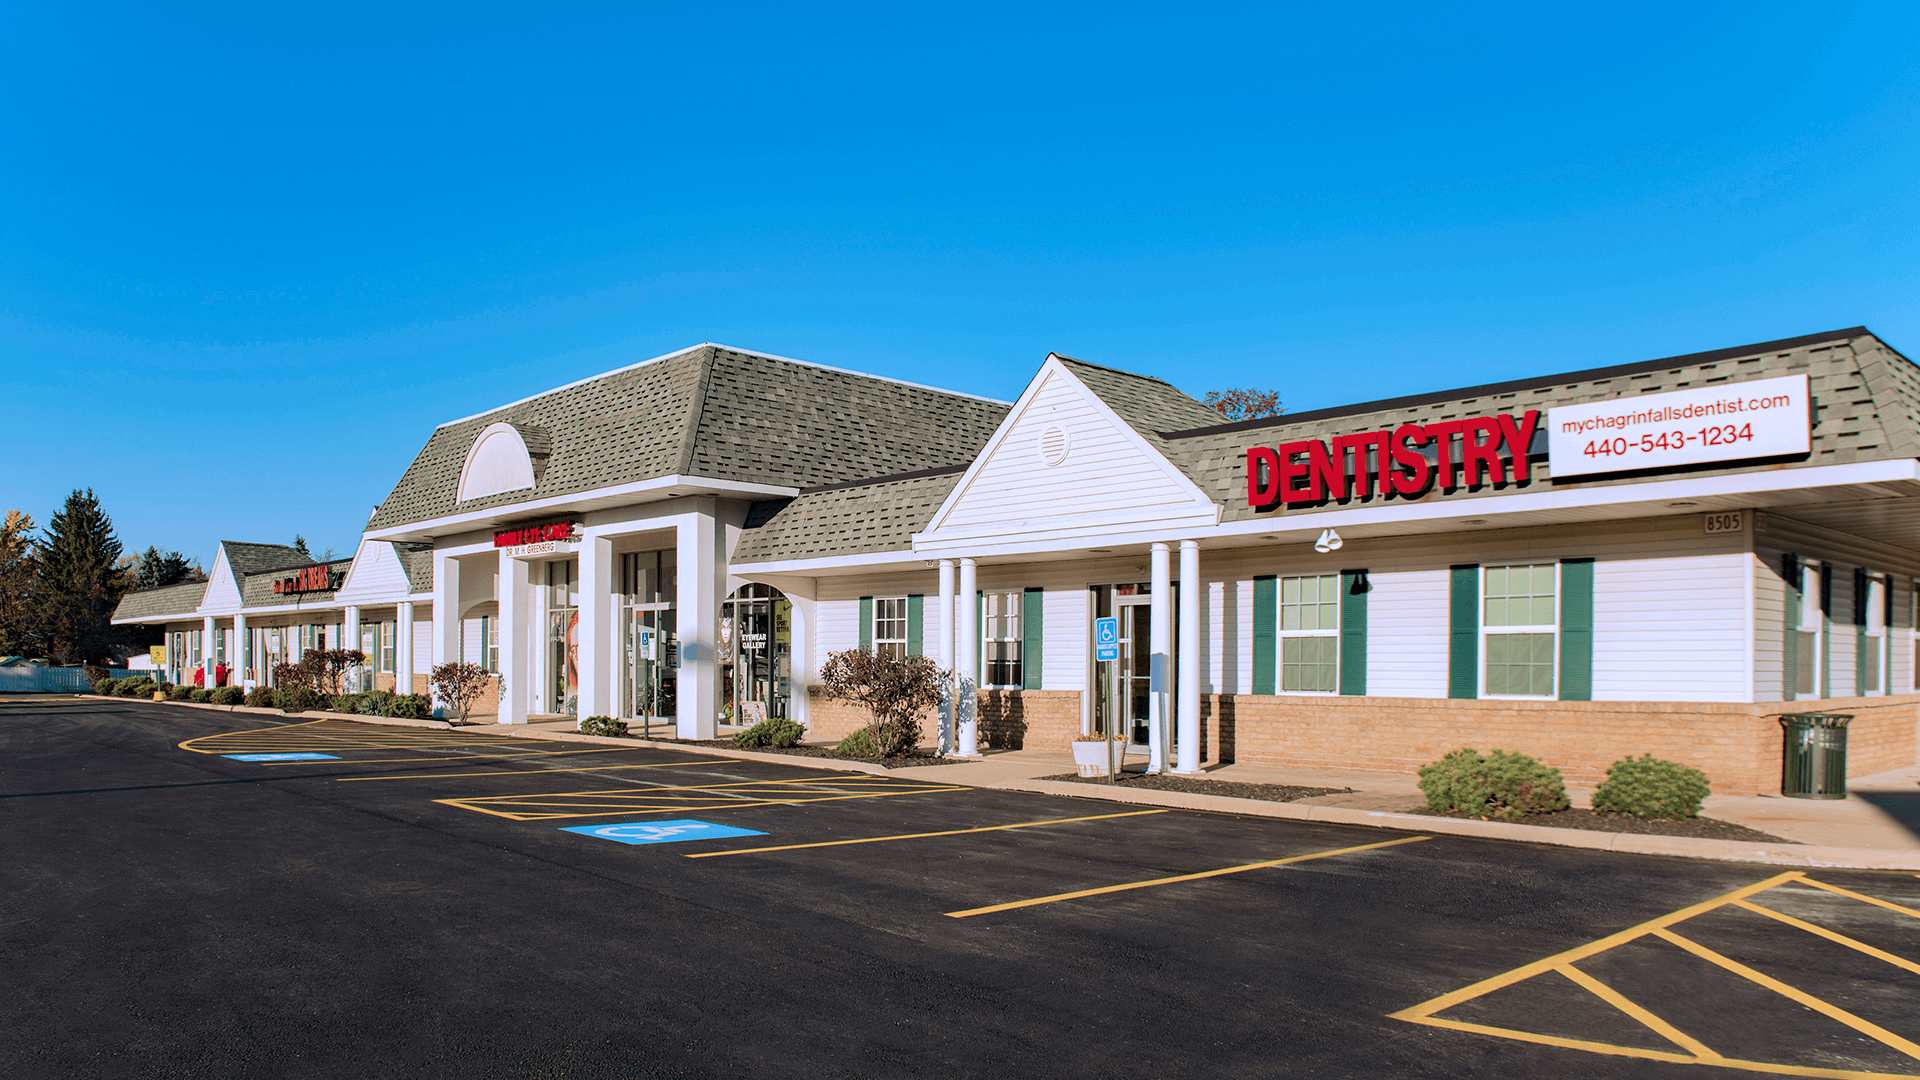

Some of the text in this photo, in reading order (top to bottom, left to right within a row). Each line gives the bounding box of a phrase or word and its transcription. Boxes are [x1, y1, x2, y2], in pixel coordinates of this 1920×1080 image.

[1562, 395, 1790, 434] mychagrinfallsdentist.com
[1583, 423, 1754, 458] 440-543-1234
[1247, 410, 1540, 506] DENTISTRY
[1707, 514, 1739, 531] 8505
[527, 542, 555, 554] GREENBERG
[742, 633, 767, 641] EYEWEAR
[742, 641, 766, 649] GALLERY
